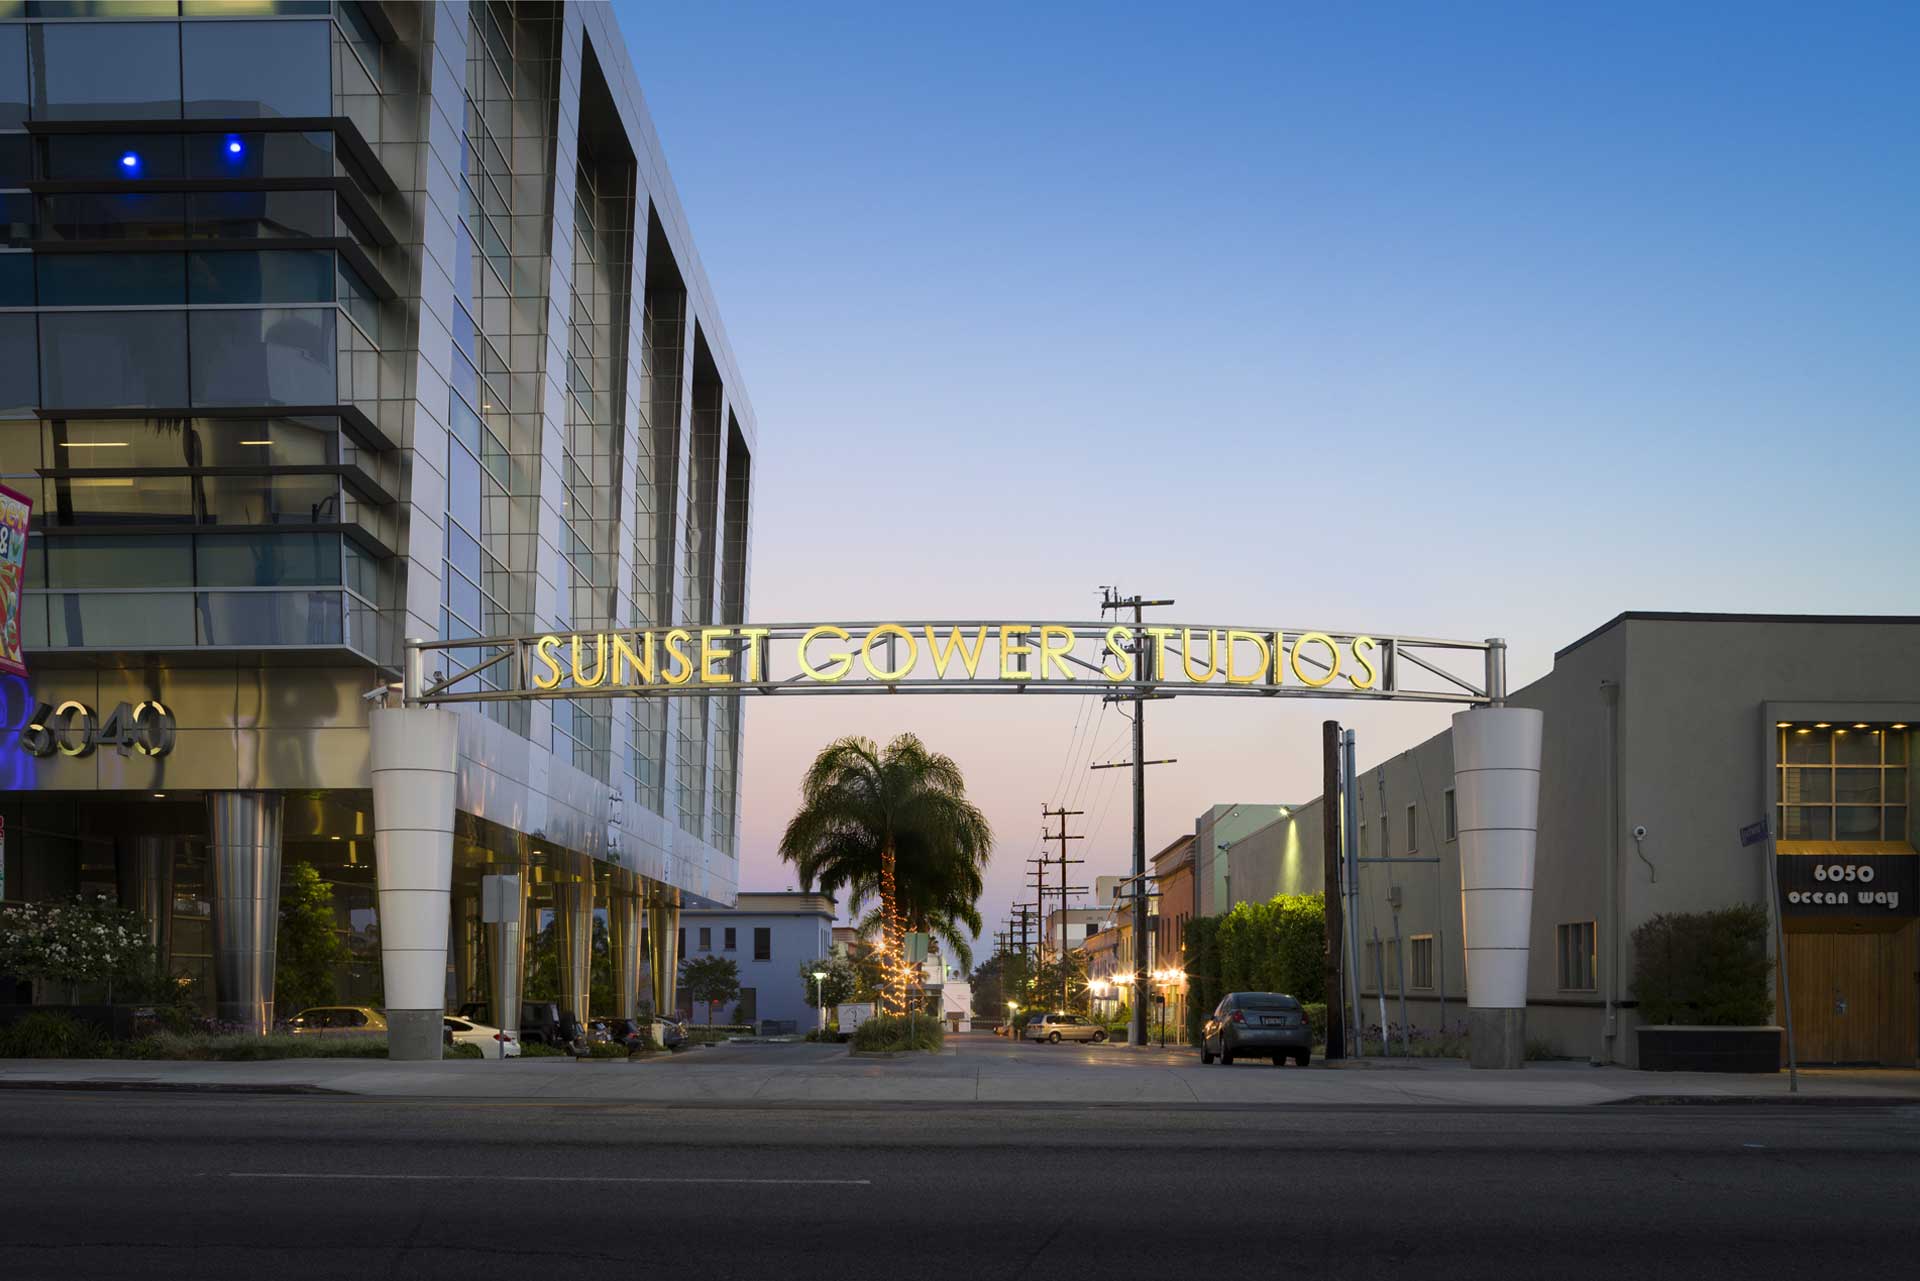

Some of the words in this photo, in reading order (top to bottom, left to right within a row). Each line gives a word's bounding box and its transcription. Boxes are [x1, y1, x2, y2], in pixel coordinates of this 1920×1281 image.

[533, 628, 771, 689] SUNSET
[798, 624, 1076, 681] GOWER
[1101, 626, 1377, 690] STUDIOS
[20, 700, 175, 758] 6040
[1814, 865, 1875, 882] 6050
[1788, 891, 1849, 905] ocean
[1858, 891, 1899, 909] way
